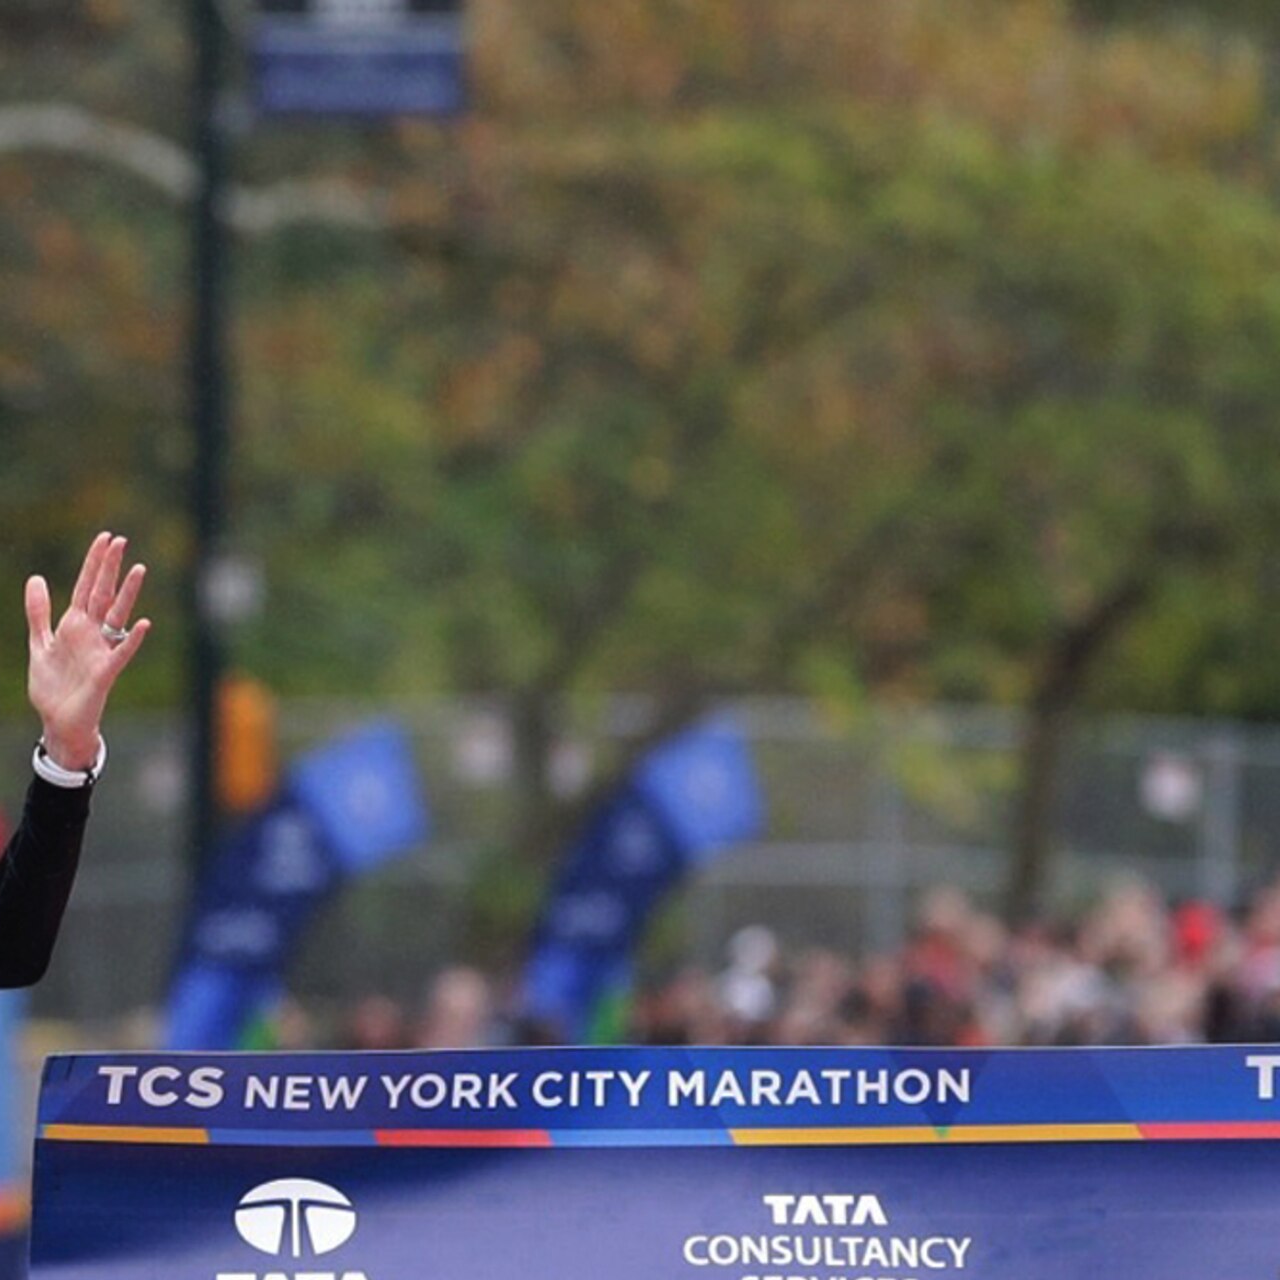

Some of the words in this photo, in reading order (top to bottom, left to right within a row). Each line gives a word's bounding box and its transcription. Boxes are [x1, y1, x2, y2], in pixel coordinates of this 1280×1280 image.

[98, 1066, 224, 1107] TCS
[244, 1075, 368, 1110] NEW
[381, 1073, 517, 1108] YORK
[532, 1071, 650, 1107] CITY
[668, 1068, 971, 1106] MARATHON
[763, 1194, 888, 1226] TATA
[682, 1234, 972, 1269] CONSULTANCY
